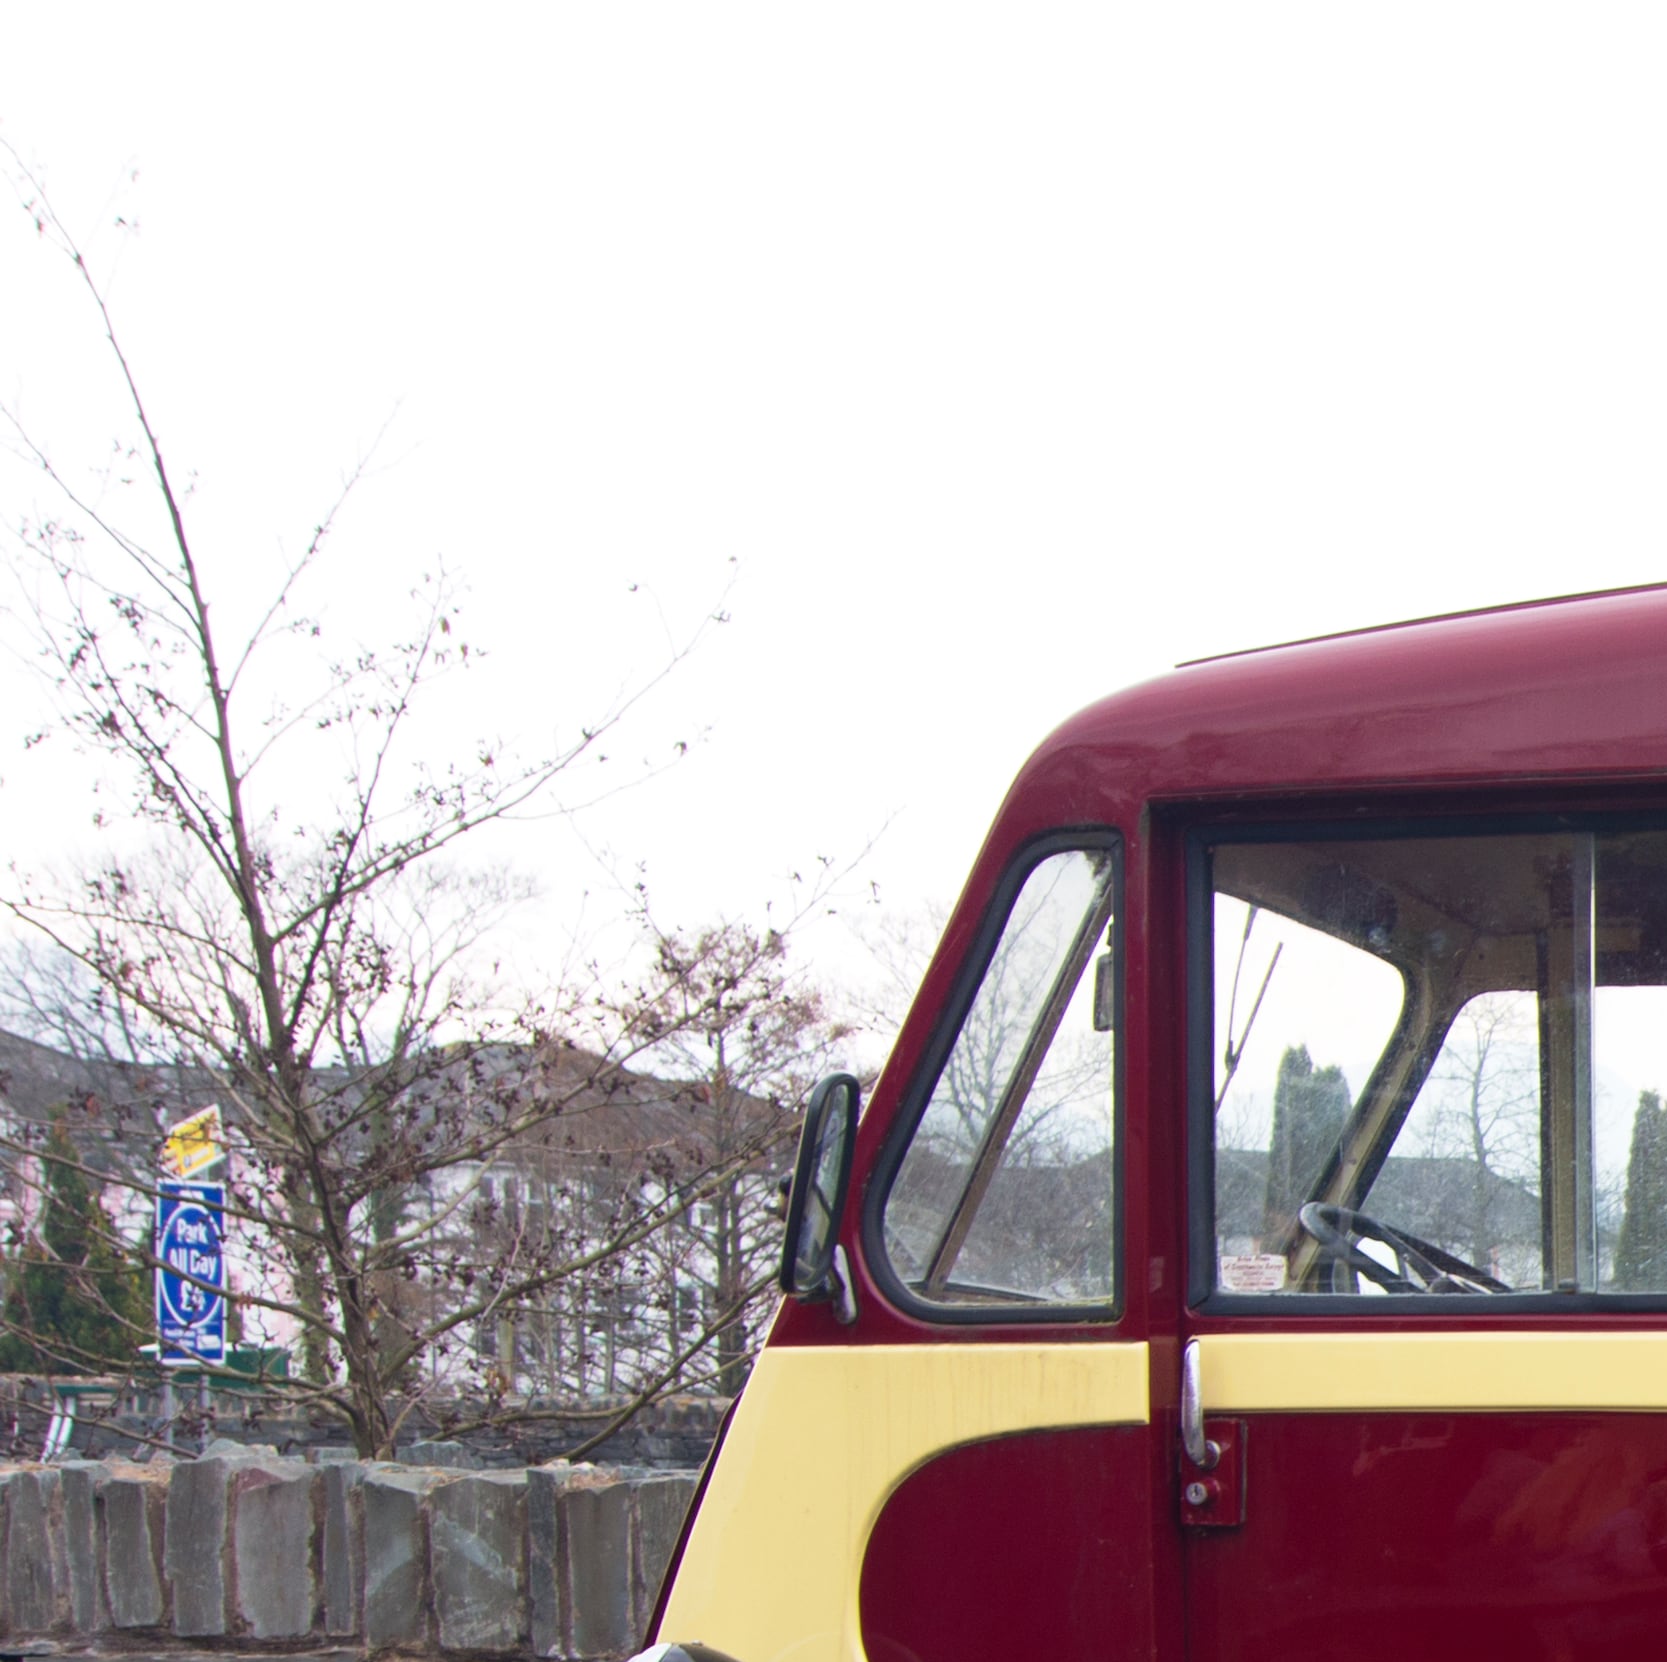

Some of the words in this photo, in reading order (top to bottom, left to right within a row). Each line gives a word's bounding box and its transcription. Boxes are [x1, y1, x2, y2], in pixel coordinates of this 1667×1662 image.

[176, 1217, 209, 1244] Park
[169, 1248, 188, 1274] All
[189, 1249, 217, 1282] Day
